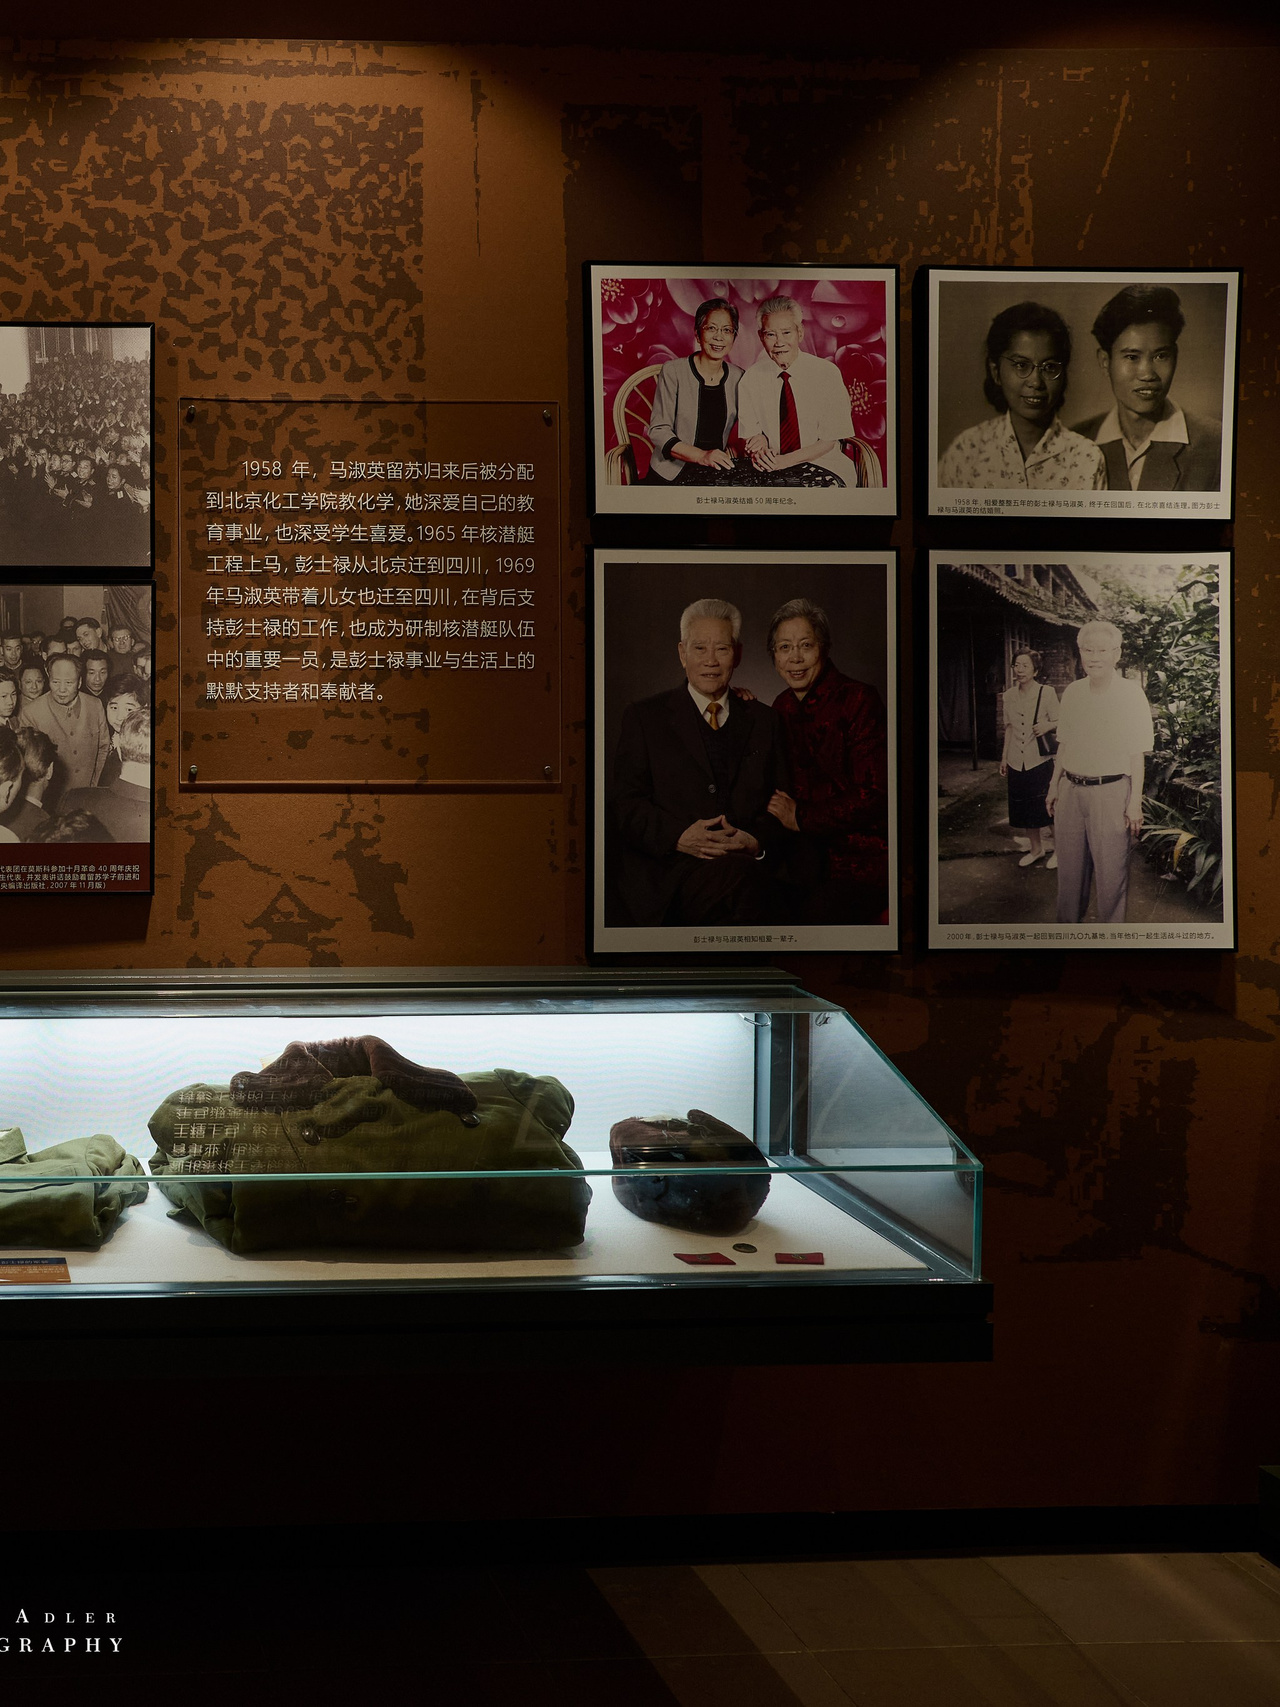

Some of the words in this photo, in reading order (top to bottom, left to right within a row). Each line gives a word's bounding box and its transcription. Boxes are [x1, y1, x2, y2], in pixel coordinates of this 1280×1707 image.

[206, 682, 384, 702] 默默支持者和奉献者。
